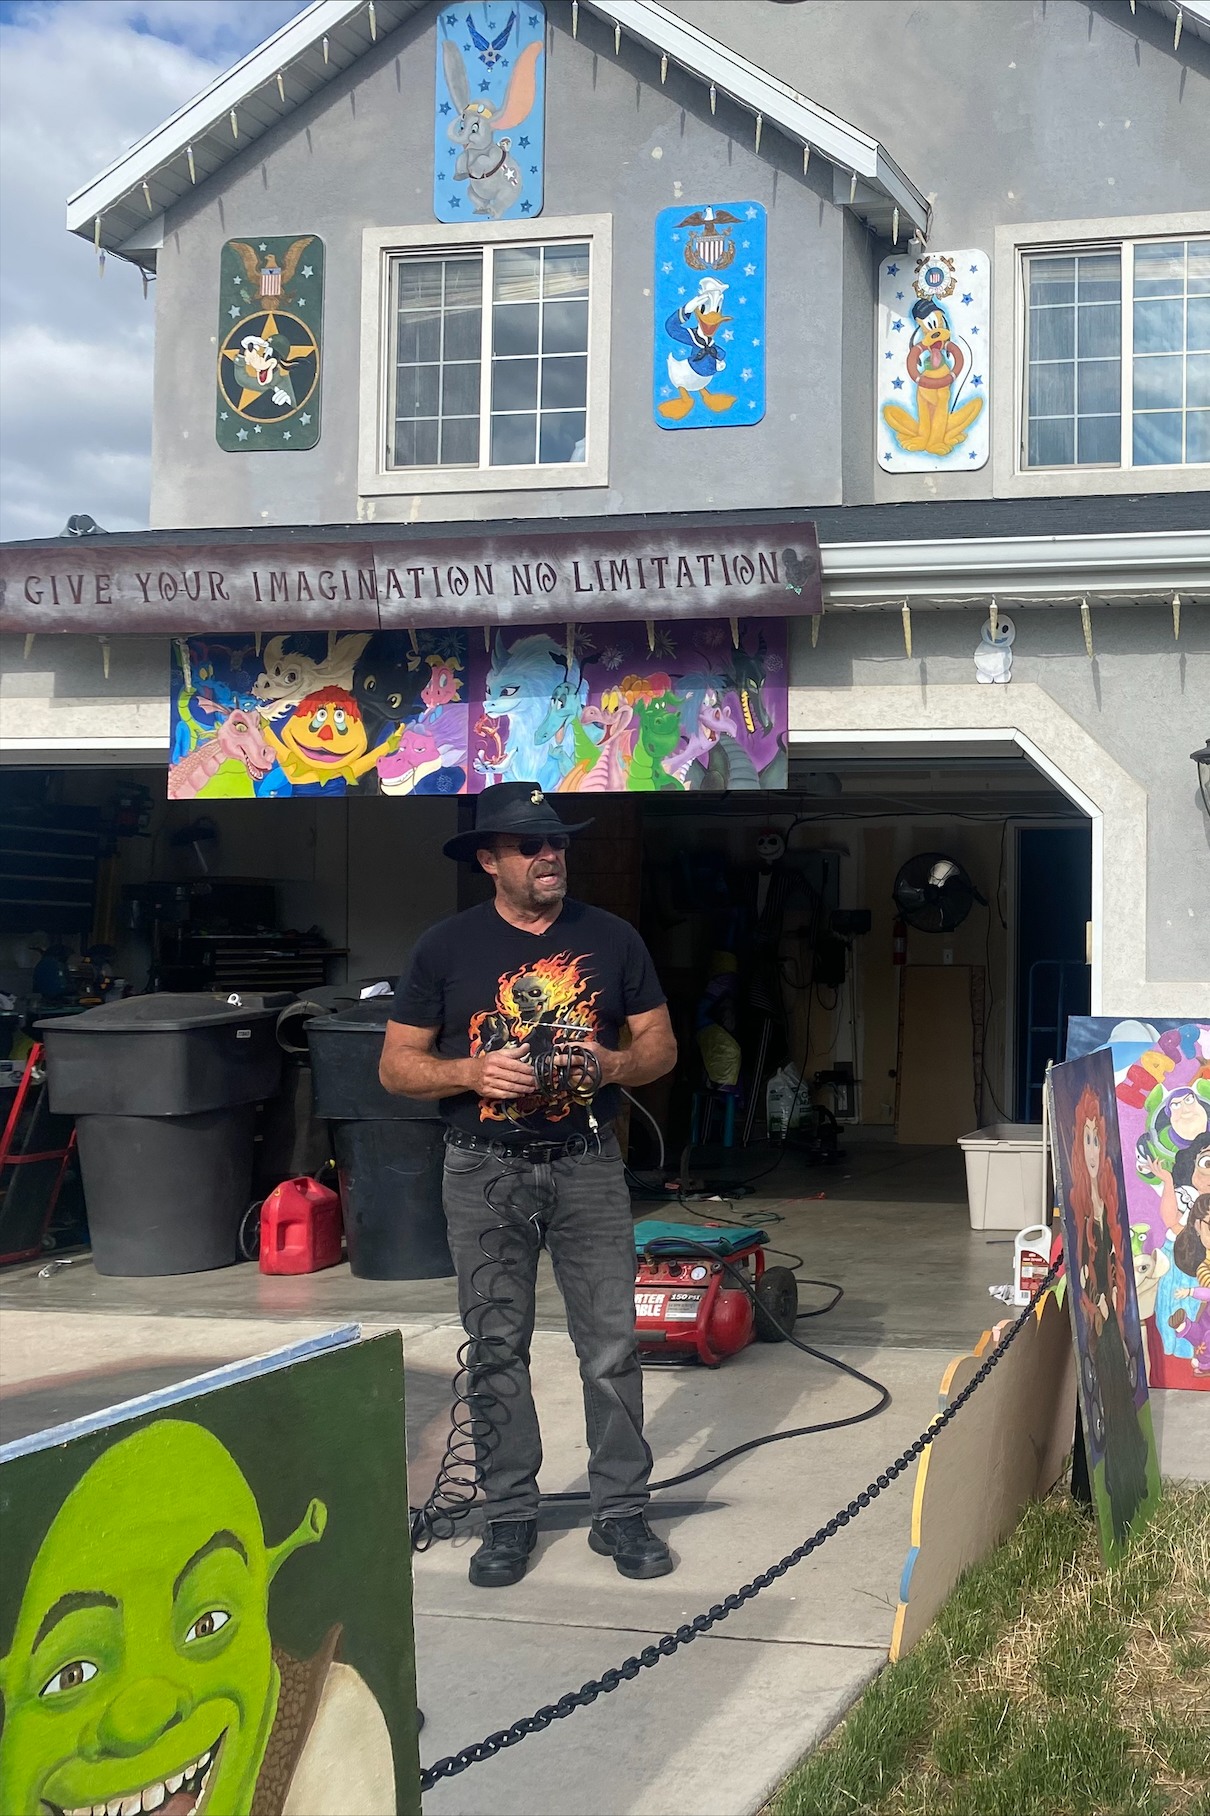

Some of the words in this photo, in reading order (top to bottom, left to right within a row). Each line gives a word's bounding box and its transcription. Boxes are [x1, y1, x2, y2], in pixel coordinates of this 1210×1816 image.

[24, 574, 113, 605] GIVE
[135, 570, 230, 603] YOUR
[252, 564, 495, 603] IMAGINATION
[512, 561, 558, 597] NO
[572, 550, 781, 594] LIMITATION
[634, 1293, 665, 1304] RTER
[671, 1293, 688, 1301] 150
